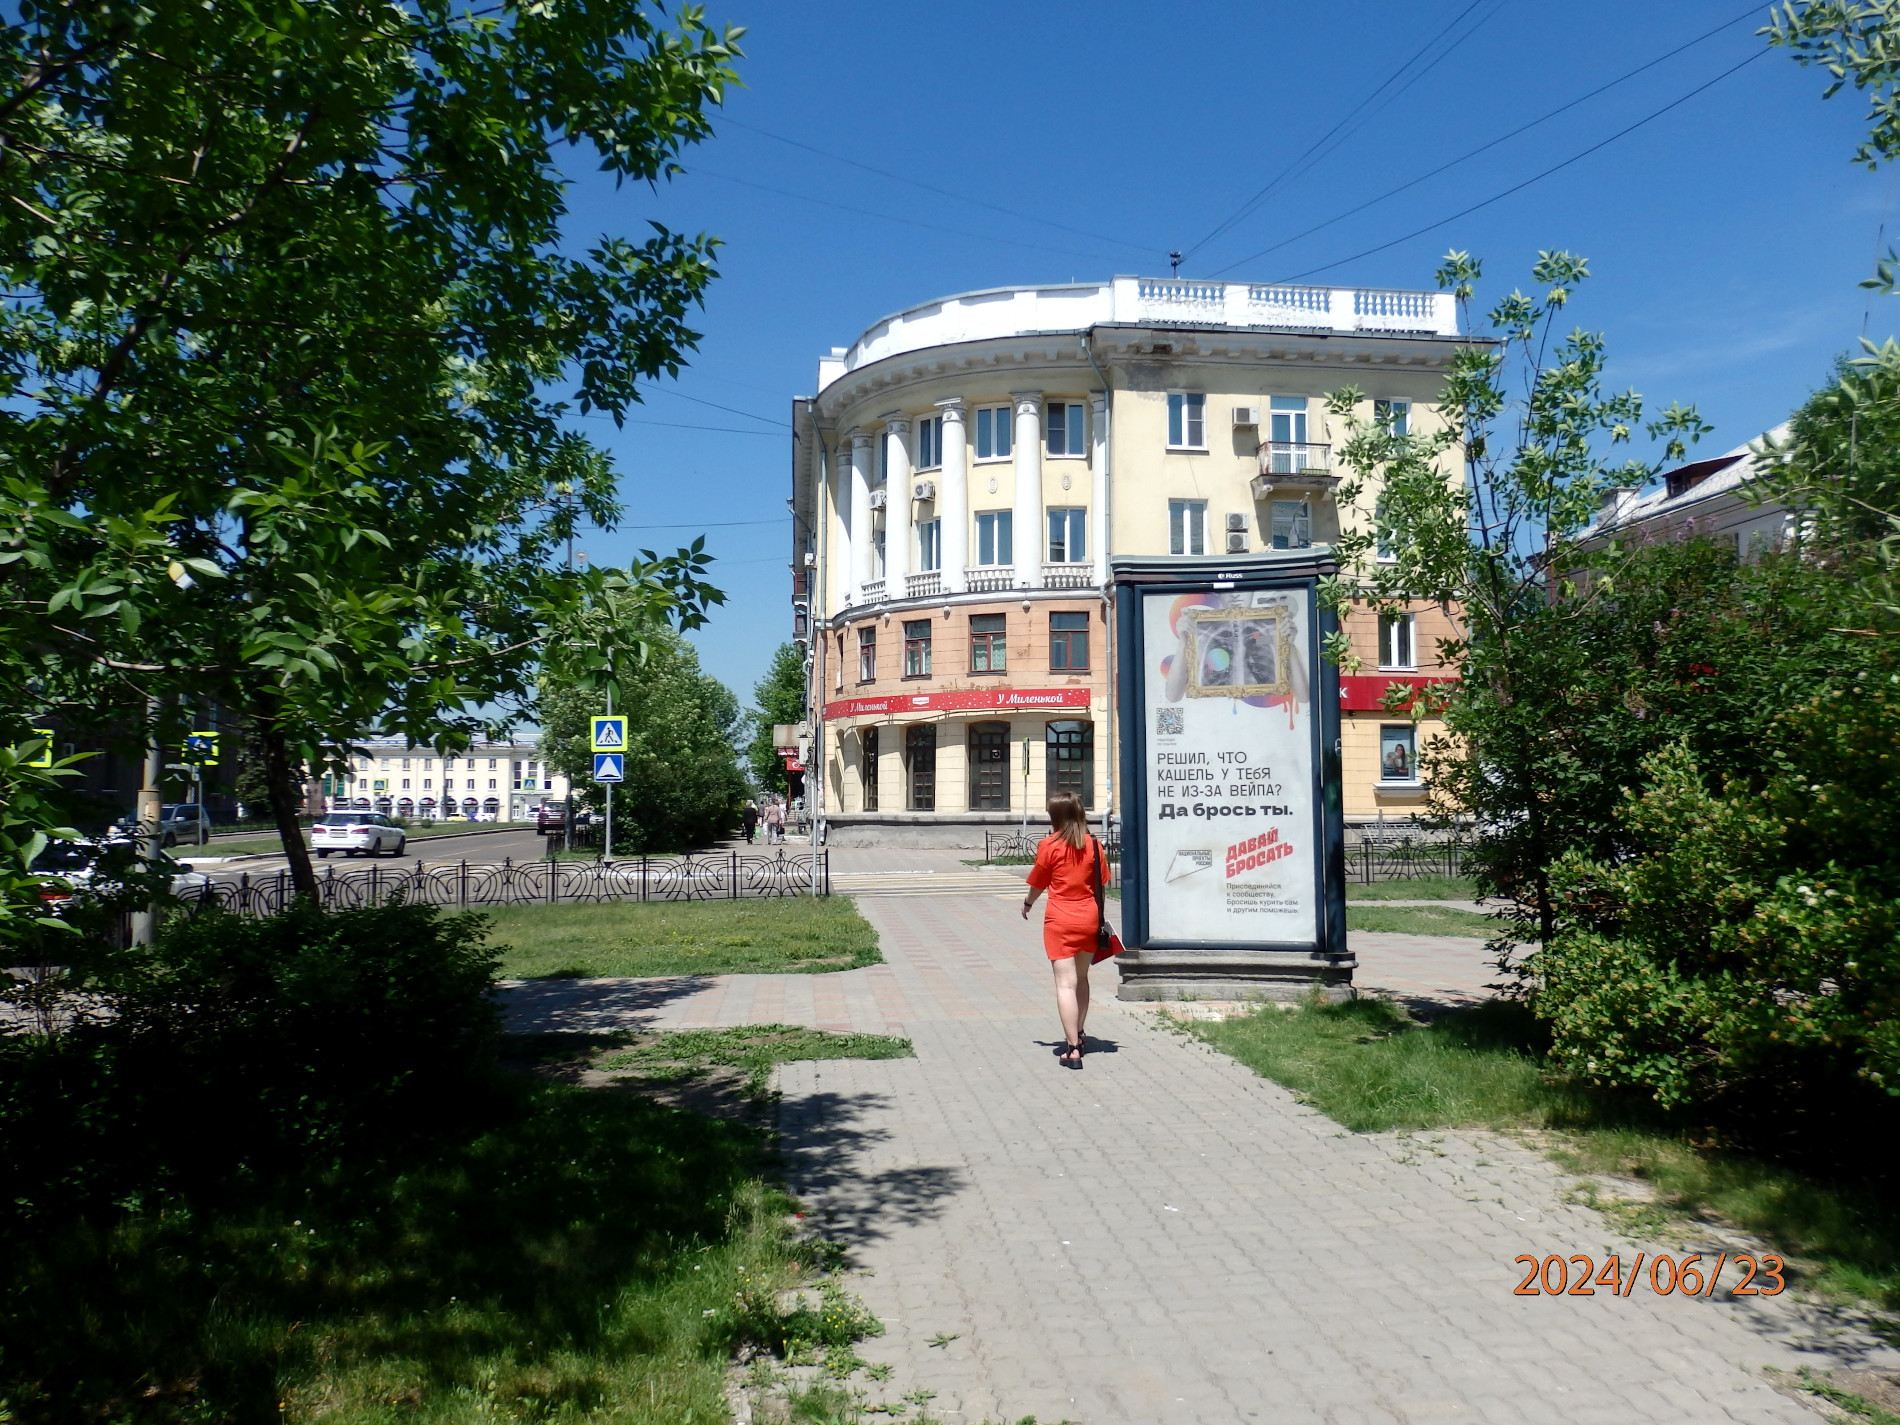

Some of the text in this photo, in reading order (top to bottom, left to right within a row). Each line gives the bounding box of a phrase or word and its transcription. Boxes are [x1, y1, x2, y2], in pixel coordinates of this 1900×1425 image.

[997, 693, 1063, 704] У Миленькой
[1157, 752, 1247, 766] РЕШИЛ, ЧТО
[1157, 769, 1214, 781] КАШЕЛЬ
[1222, 769, 1229, 781] У
[1157, 782, 1282, 797] НЕ ИЗ-ЗА ВЕЙПА?
[1158, 803, 1293, 820] Да брось ты.
[1226, 826, 1279, 864] ДАВАЙ
[1226, 842, 1294, 879] БРОСАТЬ
